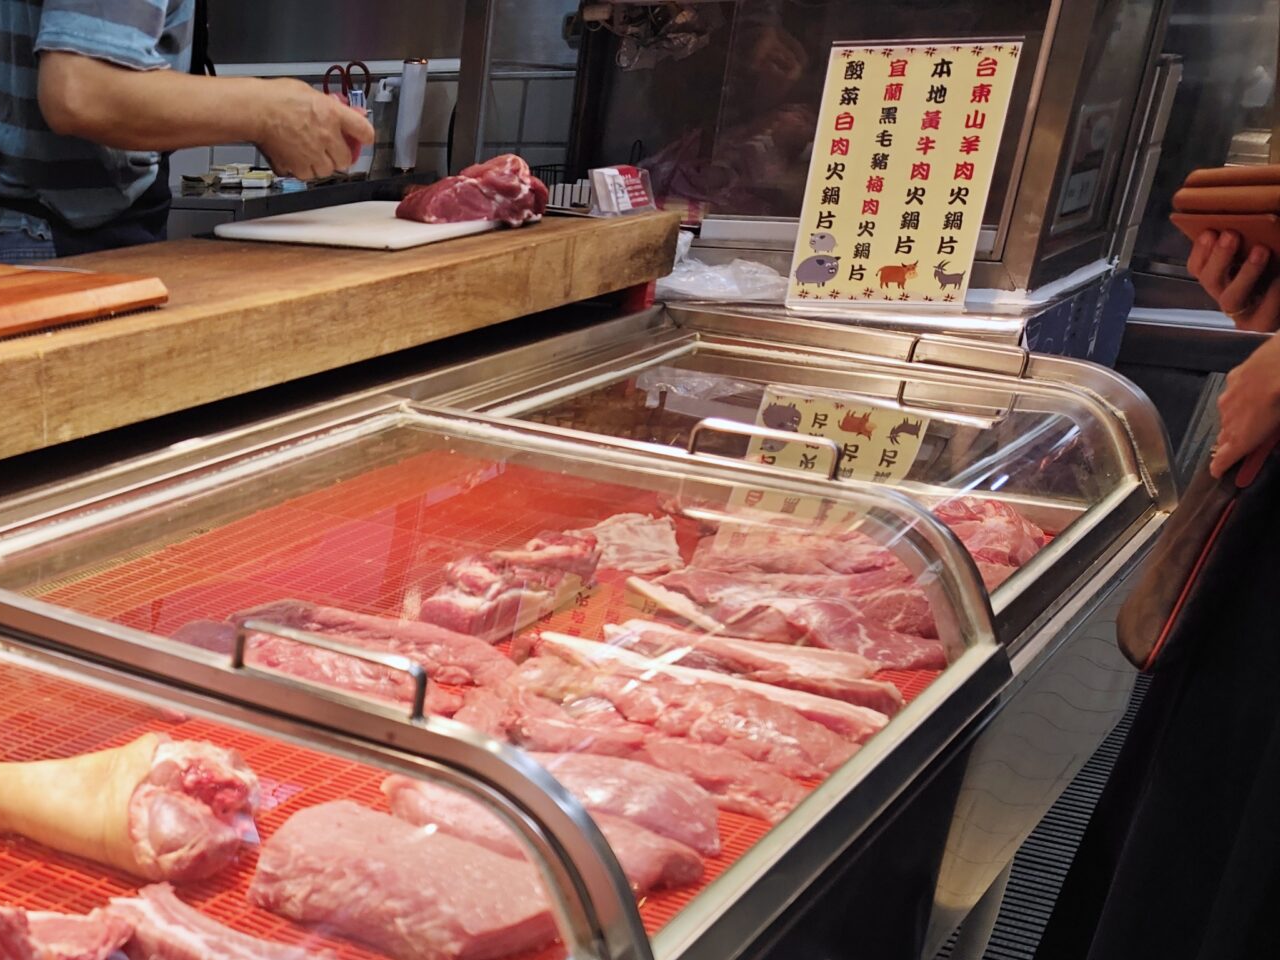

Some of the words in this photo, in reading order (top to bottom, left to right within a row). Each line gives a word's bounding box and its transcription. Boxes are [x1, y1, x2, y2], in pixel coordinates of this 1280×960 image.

[816, 61, 865, 230] 酸菜白肉火鍋片
[849, 59, 909, 282] 宜蘭黑毛豬梅肉火鍋片
[895, 58, 953, 255] 本地黃牛肉火鍋片
[937, 57, 998, 255] 台東山羊肉火鍋片
